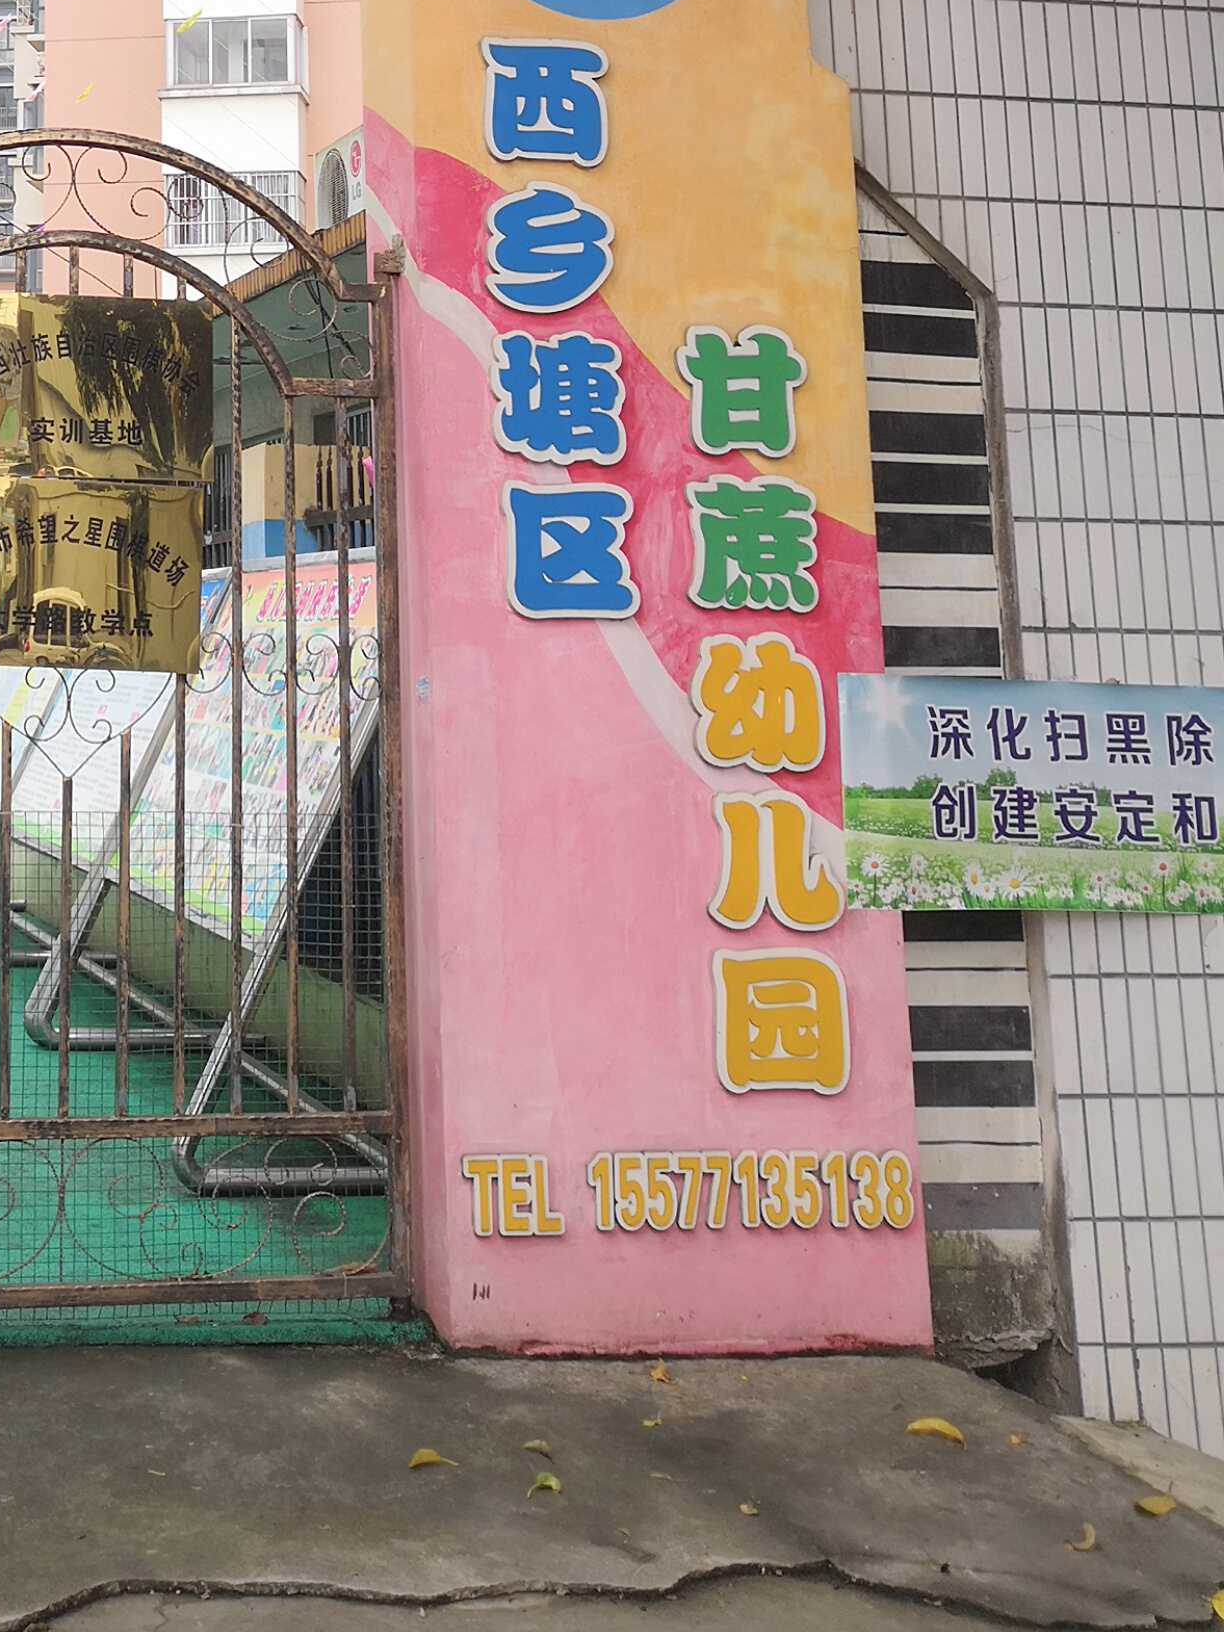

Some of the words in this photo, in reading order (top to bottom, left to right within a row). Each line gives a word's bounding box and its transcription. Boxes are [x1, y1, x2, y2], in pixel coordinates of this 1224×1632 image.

[351, 181, 362, 201] LG
[482, 37, 640, 620] 西乡塘区
[30, 416, 143, 445] 实训基地
[677, 326, 848, 1095] 甘蔗幼儿园
[926, 704, 1215, 766] 深化扫黑除
[931, 784, 1218, 845] 创建安定和
[464, 1154, 565, 1236] TEL
[587, 1150, 914, 1230] 15577135138
